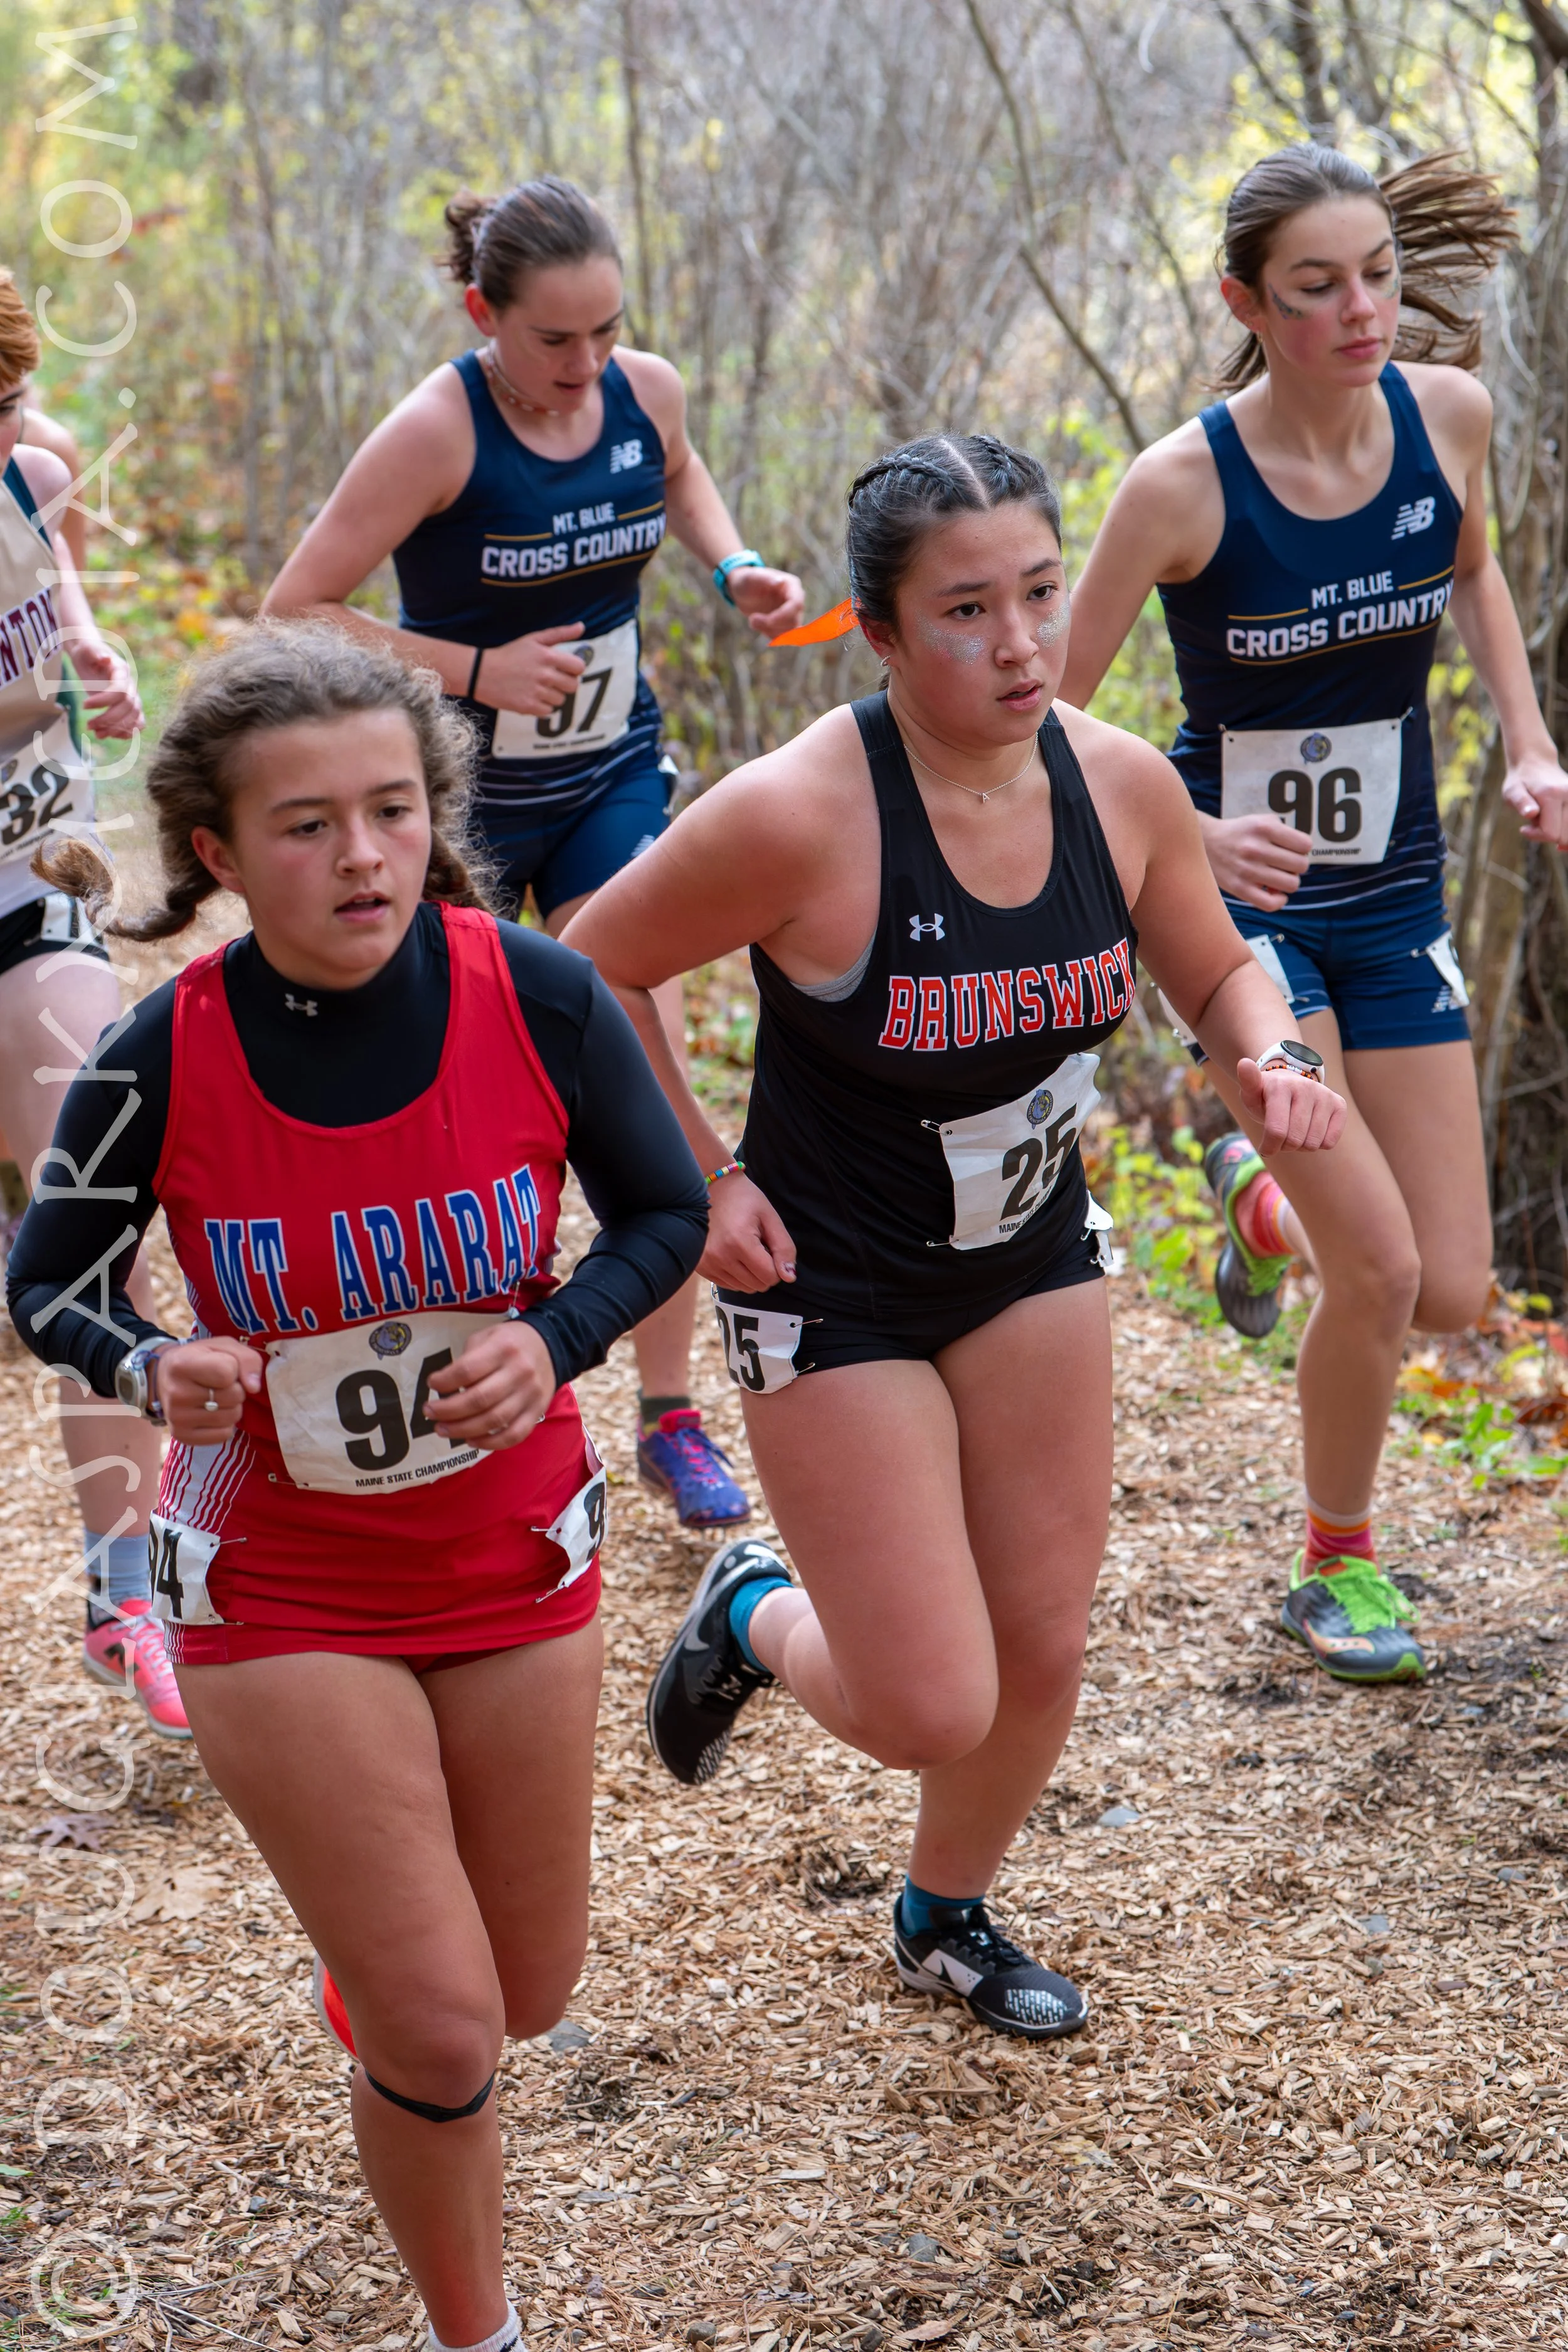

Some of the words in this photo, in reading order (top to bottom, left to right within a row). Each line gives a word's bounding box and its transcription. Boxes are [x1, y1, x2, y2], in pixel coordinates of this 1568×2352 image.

[481, 542, 568, 578] CROSS
[574, 512, 667, 566] COUNTRY
[553, 512, 578, 536] MT.
[579, 502, 616, 531] BLUE
[1311, 586, 1343, 610] MT.
[1347, 571, 1394, 602] BLUE
[1227, 618, 1328, 658] CROSS
[0, 760, 73, 845] 32
[1268, 767, 1362, 842] 96
[878, 937, 1135, 1051] BRUNSWICK
[999, 1103, 1077, 1222] 25
[203, 1218, 318, 1335] MT.
[330, 1164, 541, 1322] ARARAT
[999, 1221, 1022, 1234] MAINE
[355, 1476, 384, 1487] MAINE
[387, 1471, 413, 1484] STATE
[415, 1449, 479, 1478] CHAMPIONSHIP
